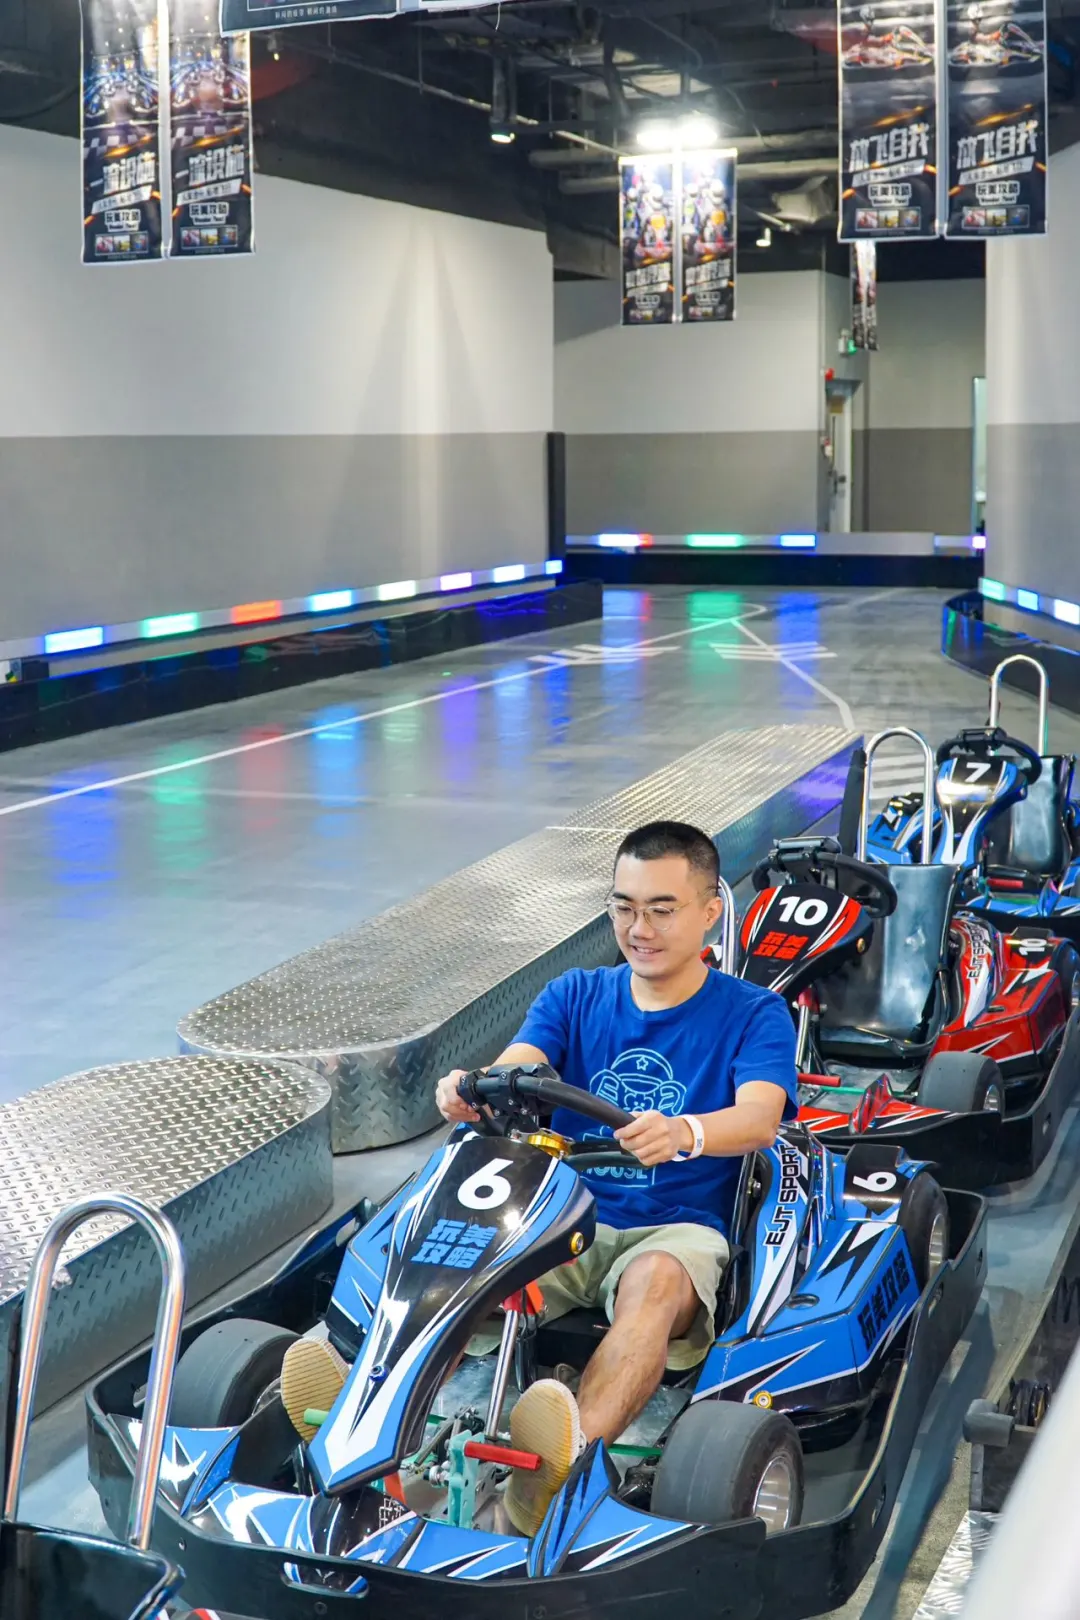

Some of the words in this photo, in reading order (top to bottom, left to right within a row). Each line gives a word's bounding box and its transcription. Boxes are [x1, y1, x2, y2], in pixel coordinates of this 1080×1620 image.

[849, 122, 929, 173] 放飞自我
[957, 120, 1038, 169] 放飞自我
[965, 762, 991, 783] 7
[778, 896, 829, 926] 10
[1019, 938, 1047, 956] 10
[457, 1158, 514, 1210] 6
[764, 1205, 791, 1247] EJT
[779, 1143, 798, 1204] SPORT
[853, 1171, 897, 1193] 6
